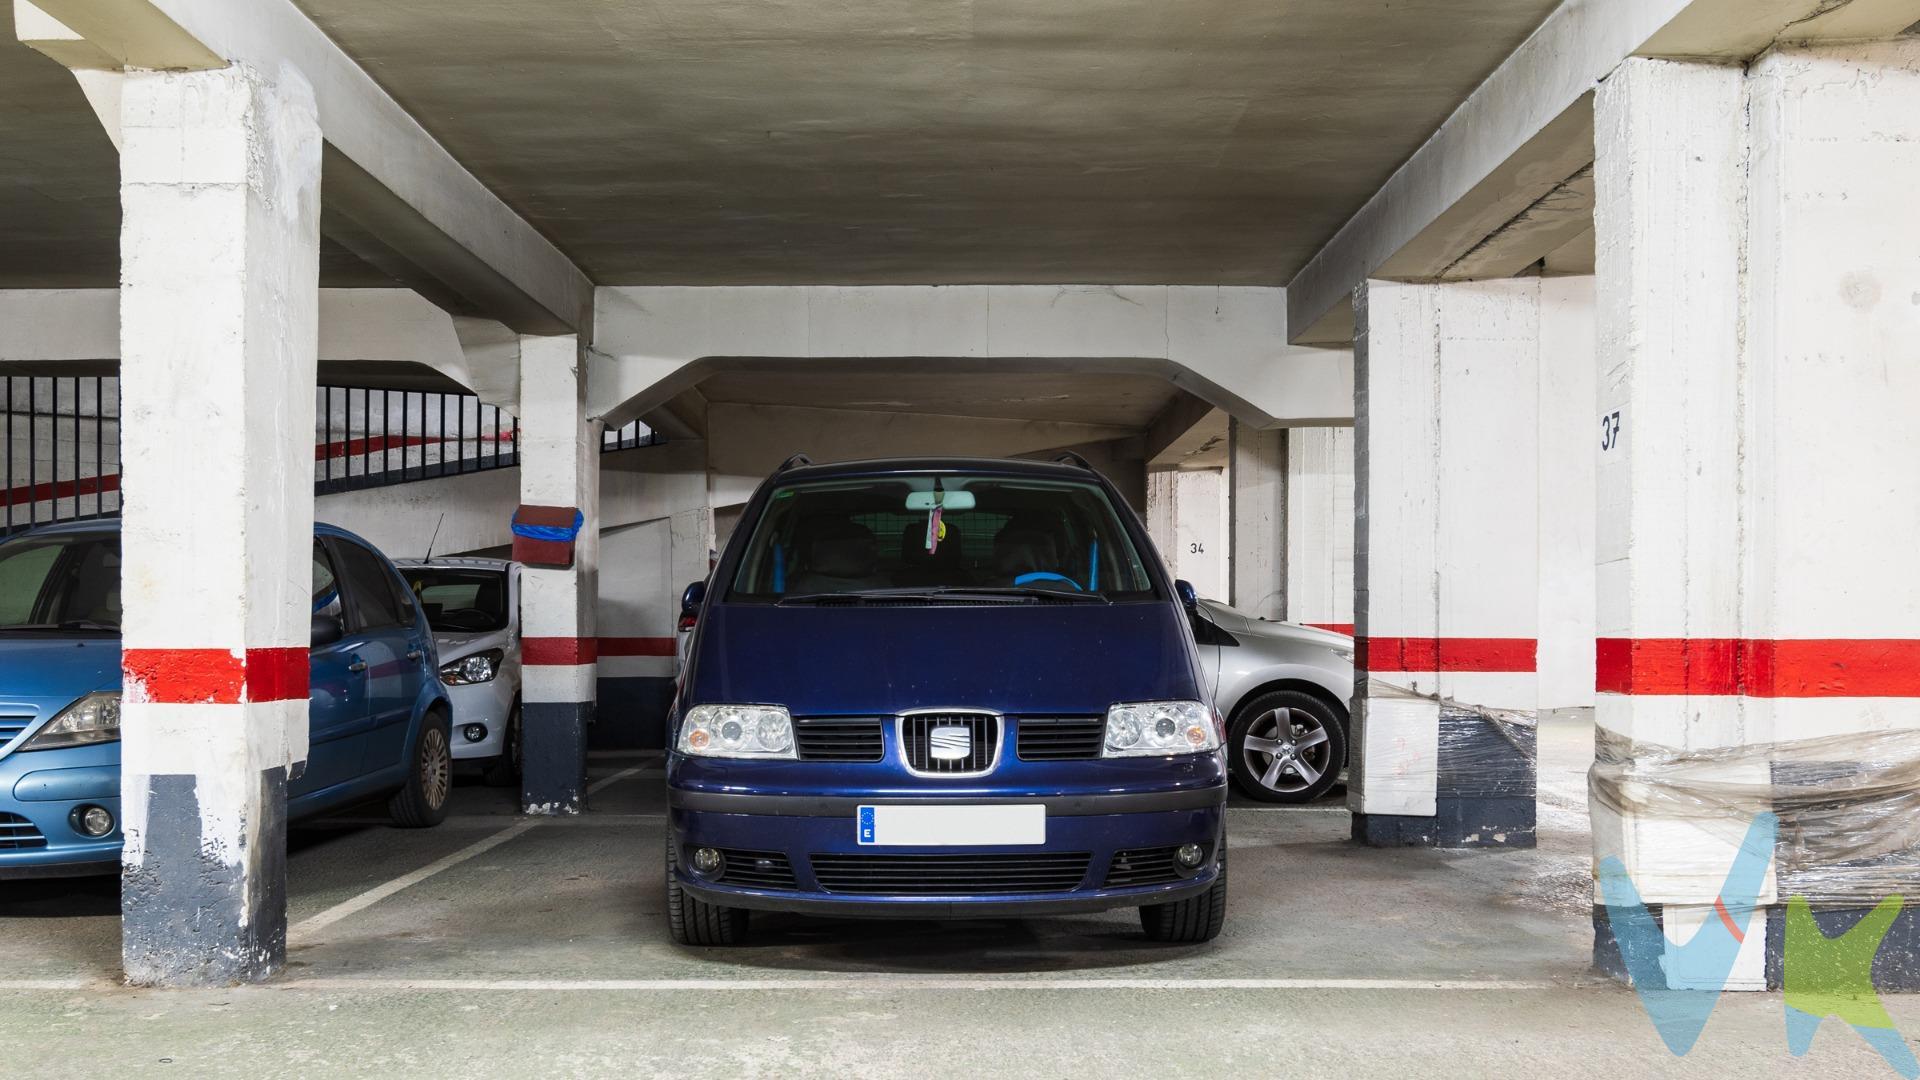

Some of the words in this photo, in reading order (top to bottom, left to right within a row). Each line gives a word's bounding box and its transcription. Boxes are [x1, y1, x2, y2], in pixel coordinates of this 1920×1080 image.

[1602, 411, 1620, 451] 37
[1190, 543, 1205, 555] 34
[863, 829, 871, 838] E
